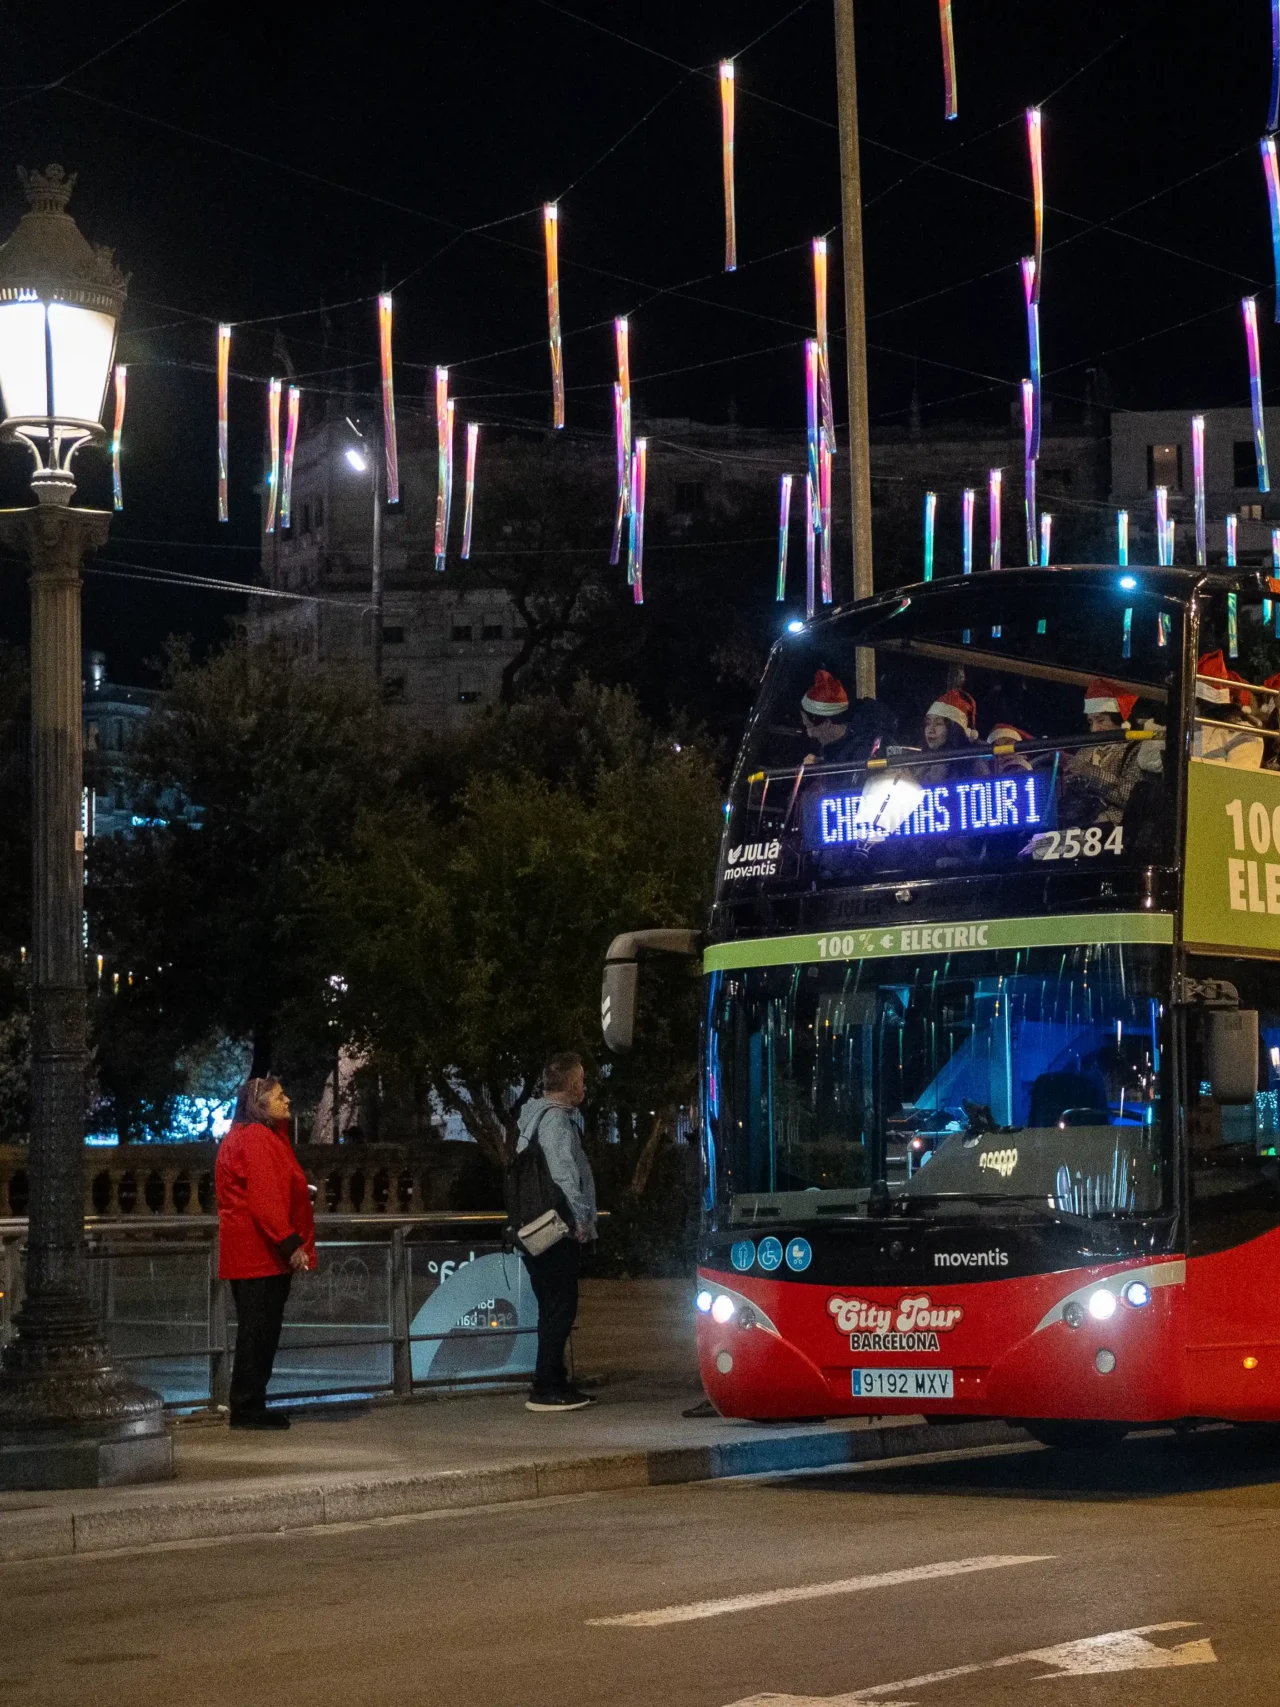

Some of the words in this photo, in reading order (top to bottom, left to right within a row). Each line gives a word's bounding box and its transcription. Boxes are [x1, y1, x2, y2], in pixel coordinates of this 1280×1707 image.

[956, 780, 1019, 830] TOUR
[1025, 777, 1041, 822] 1
[1043, 825, 1125, 861] 2584
[724, 860, 777, 881] moventis
[900, 924, 989, 952] ELECTRIC
[934, 1248, 1009, 1267] moventis
[829, 1298, 892, 1334] City
[896, 1297, 961, 1332] Tour
[850, 1332, 940, 1352] BARCELONA
[863, 1373, 908, 1393] 9192
[915, 1373, 949, 1394] MXV
